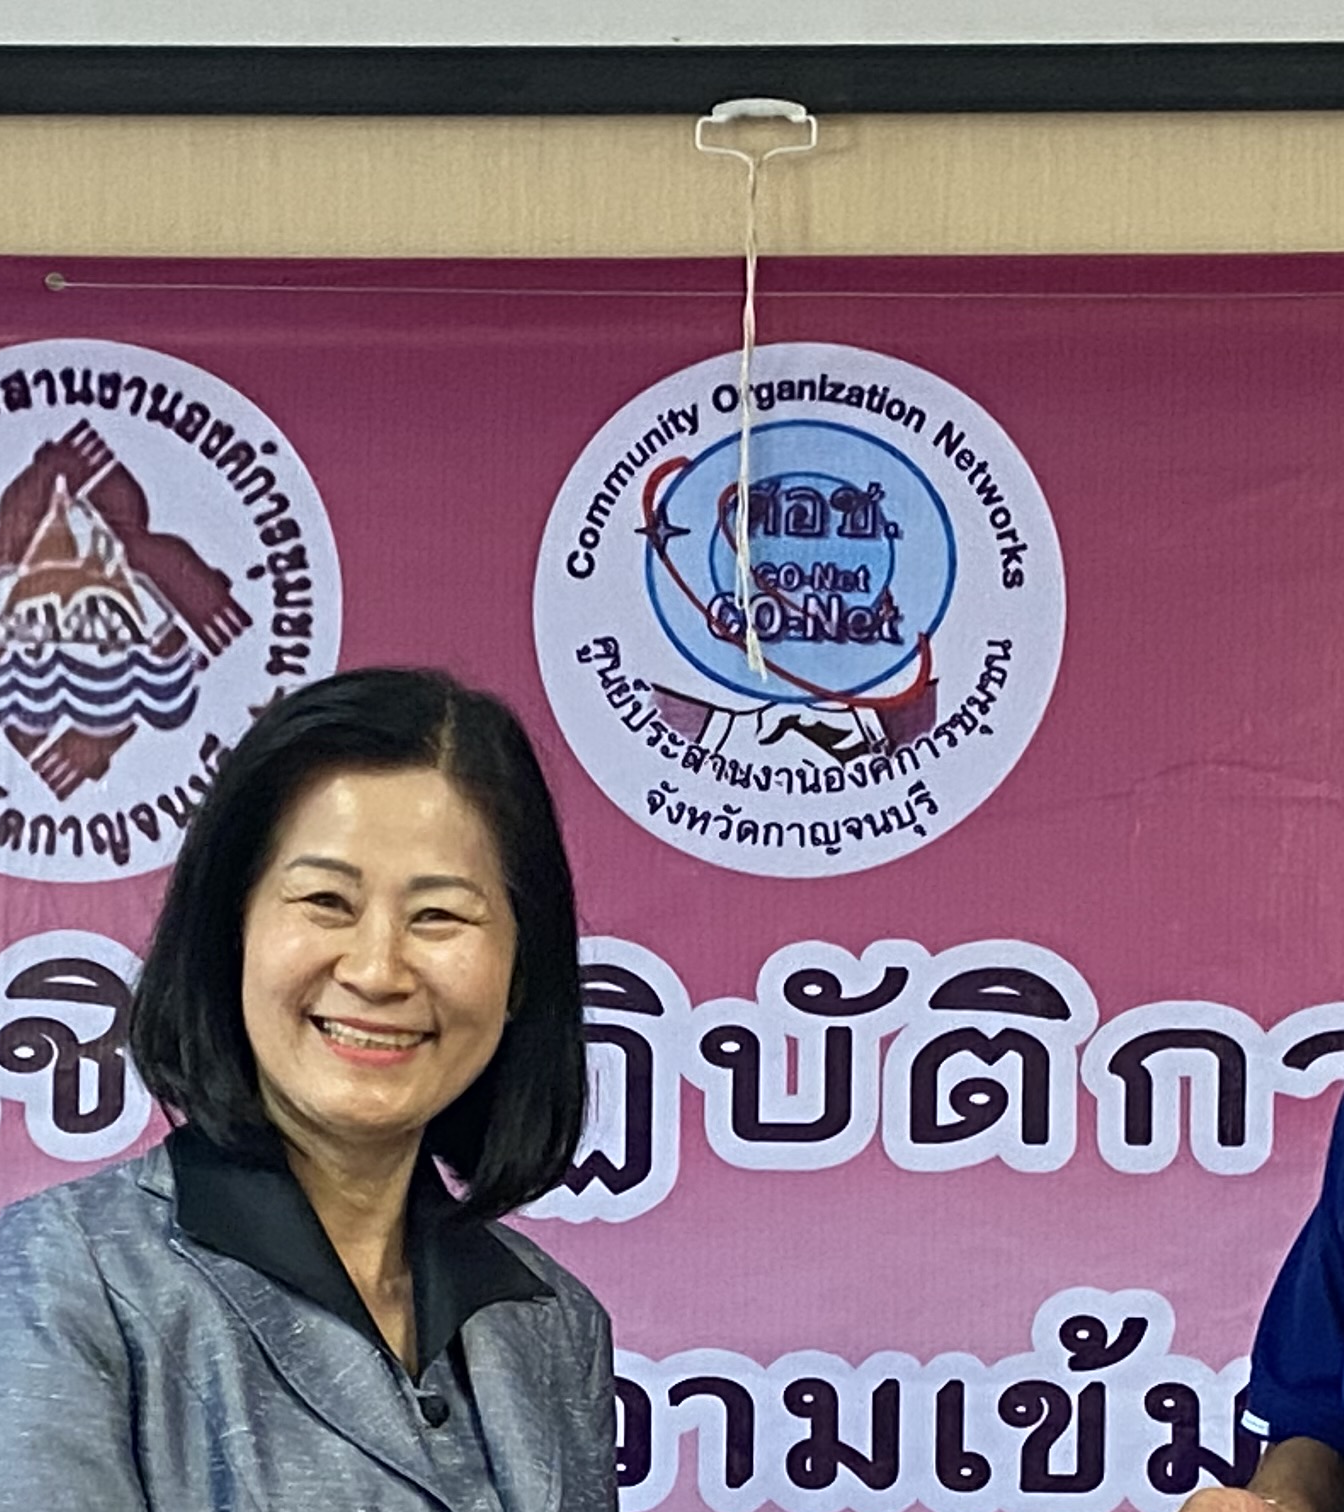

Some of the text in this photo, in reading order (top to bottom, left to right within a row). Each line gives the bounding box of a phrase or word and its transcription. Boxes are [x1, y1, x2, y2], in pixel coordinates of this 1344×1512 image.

[566, 403, 700, 580] Community
[932, 420, 1028, 591] Networks
[644, 780, 939, 856] จังหวัดกาญจนบุรี
